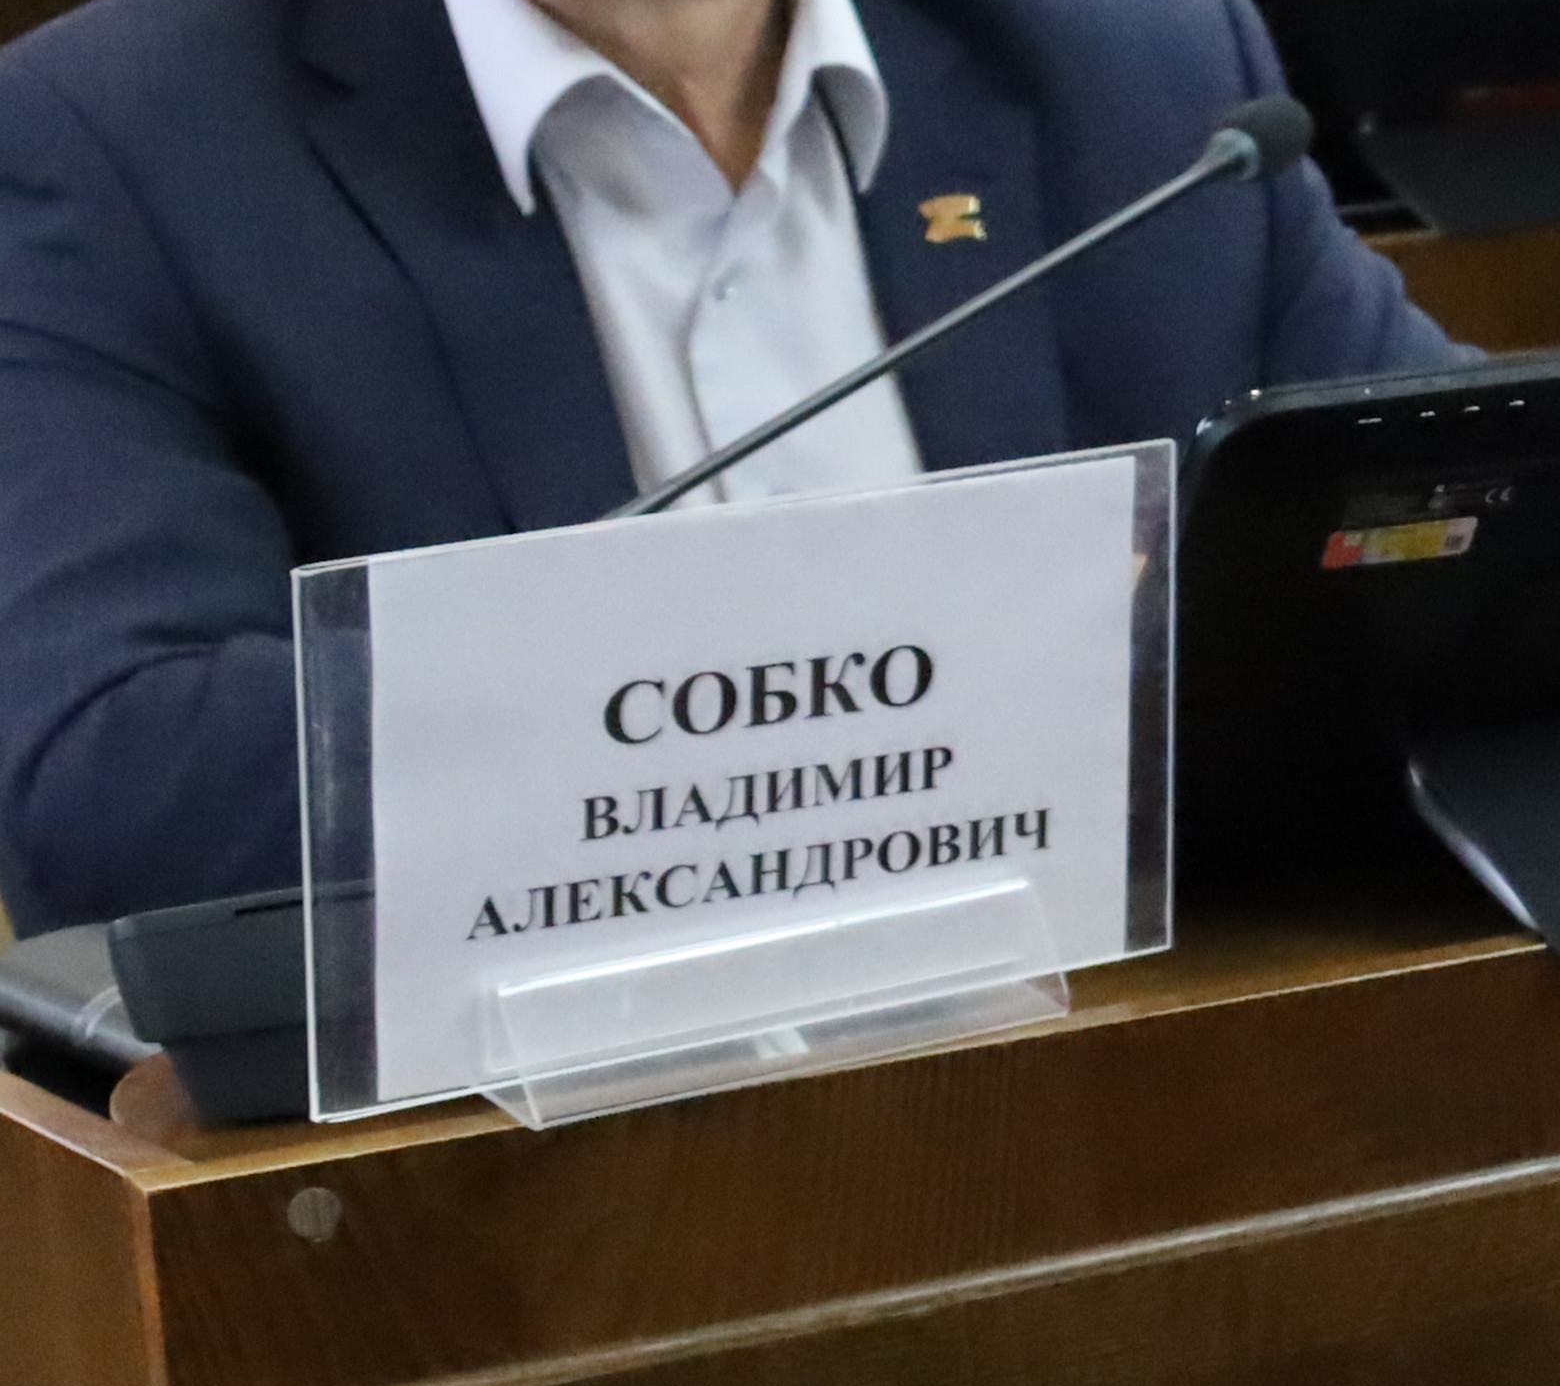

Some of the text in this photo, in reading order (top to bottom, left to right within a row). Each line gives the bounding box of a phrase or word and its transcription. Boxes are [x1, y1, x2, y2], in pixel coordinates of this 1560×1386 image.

[603, 644, 934, 745] СОБКО
[582, 746, 954, 842] ВЛАДИМИР
[466, 807, 1052, 941] АЛЕКСАНДРОВИЧ
